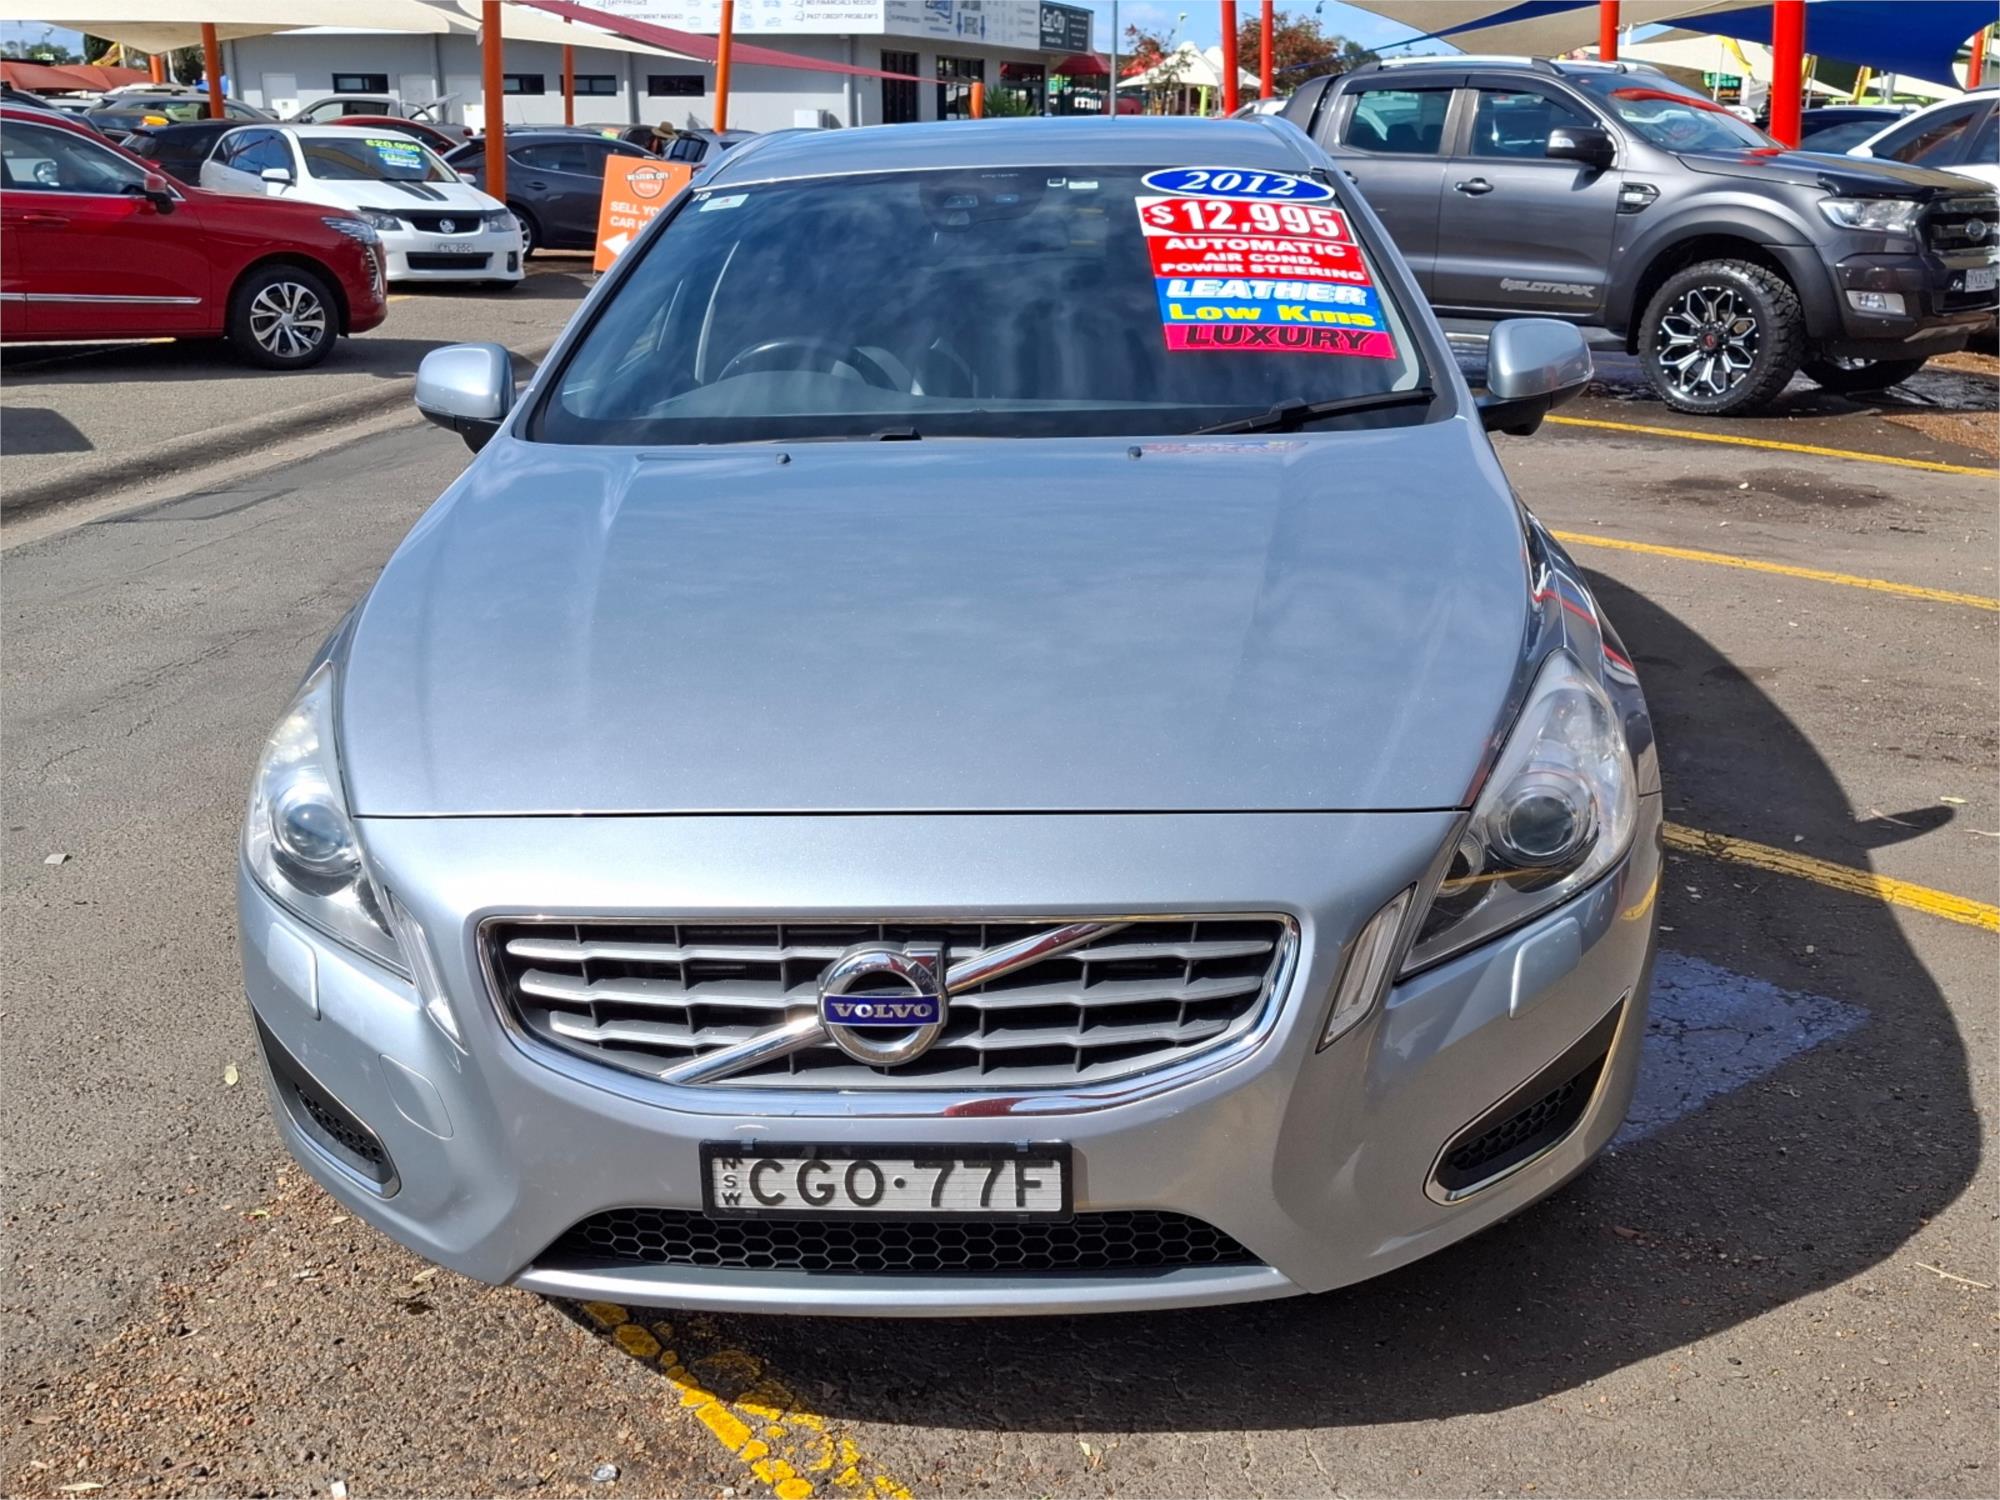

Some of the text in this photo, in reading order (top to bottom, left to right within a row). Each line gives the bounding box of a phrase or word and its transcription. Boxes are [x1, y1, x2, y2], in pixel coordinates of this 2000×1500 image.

[1177, 171, 1298, 196] 2012
[610, 201, 640, 215] SELL
[610, 216, 635, 229] CAR
[1165, 237, 1346, 257] AUTOMATIC
[1203, 252, 1320, 266] AIR COND.
[1161, 263, 1365, 281] POWER STEERING
[1166, 279, 1367, 306] LEATHER
[1169, 303, 1376, 327] Low Kms
[1185, 325, 1372, 350] LUXURY
[831, 1003, 933, 1018] VOLVO
